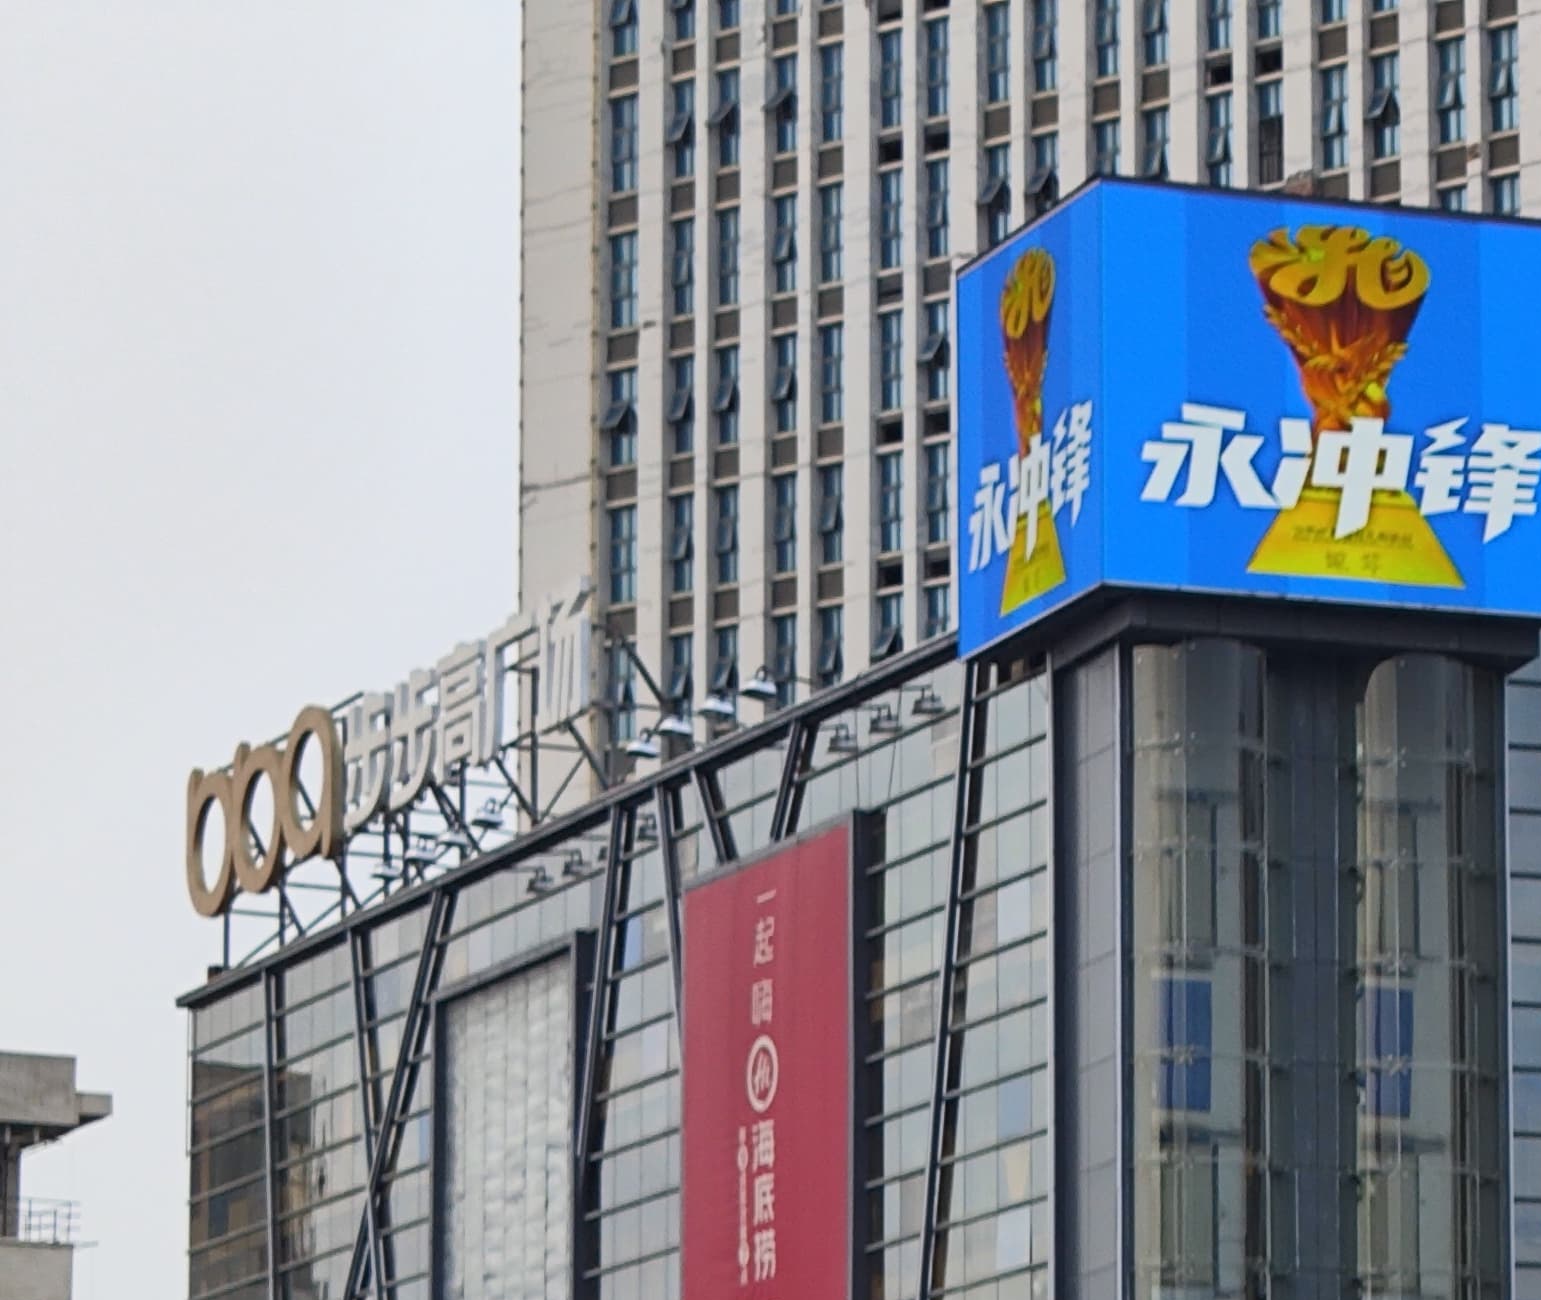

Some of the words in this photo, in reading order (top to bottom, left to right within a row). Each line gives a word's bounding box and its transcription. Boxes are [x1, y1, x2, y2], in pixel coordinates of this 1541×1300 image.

[967, 400, 1093, 572] 永冲锋
[344, 576, 592, 834] 步步高广场
[750, 1118, 777, 1283] 海底捞
